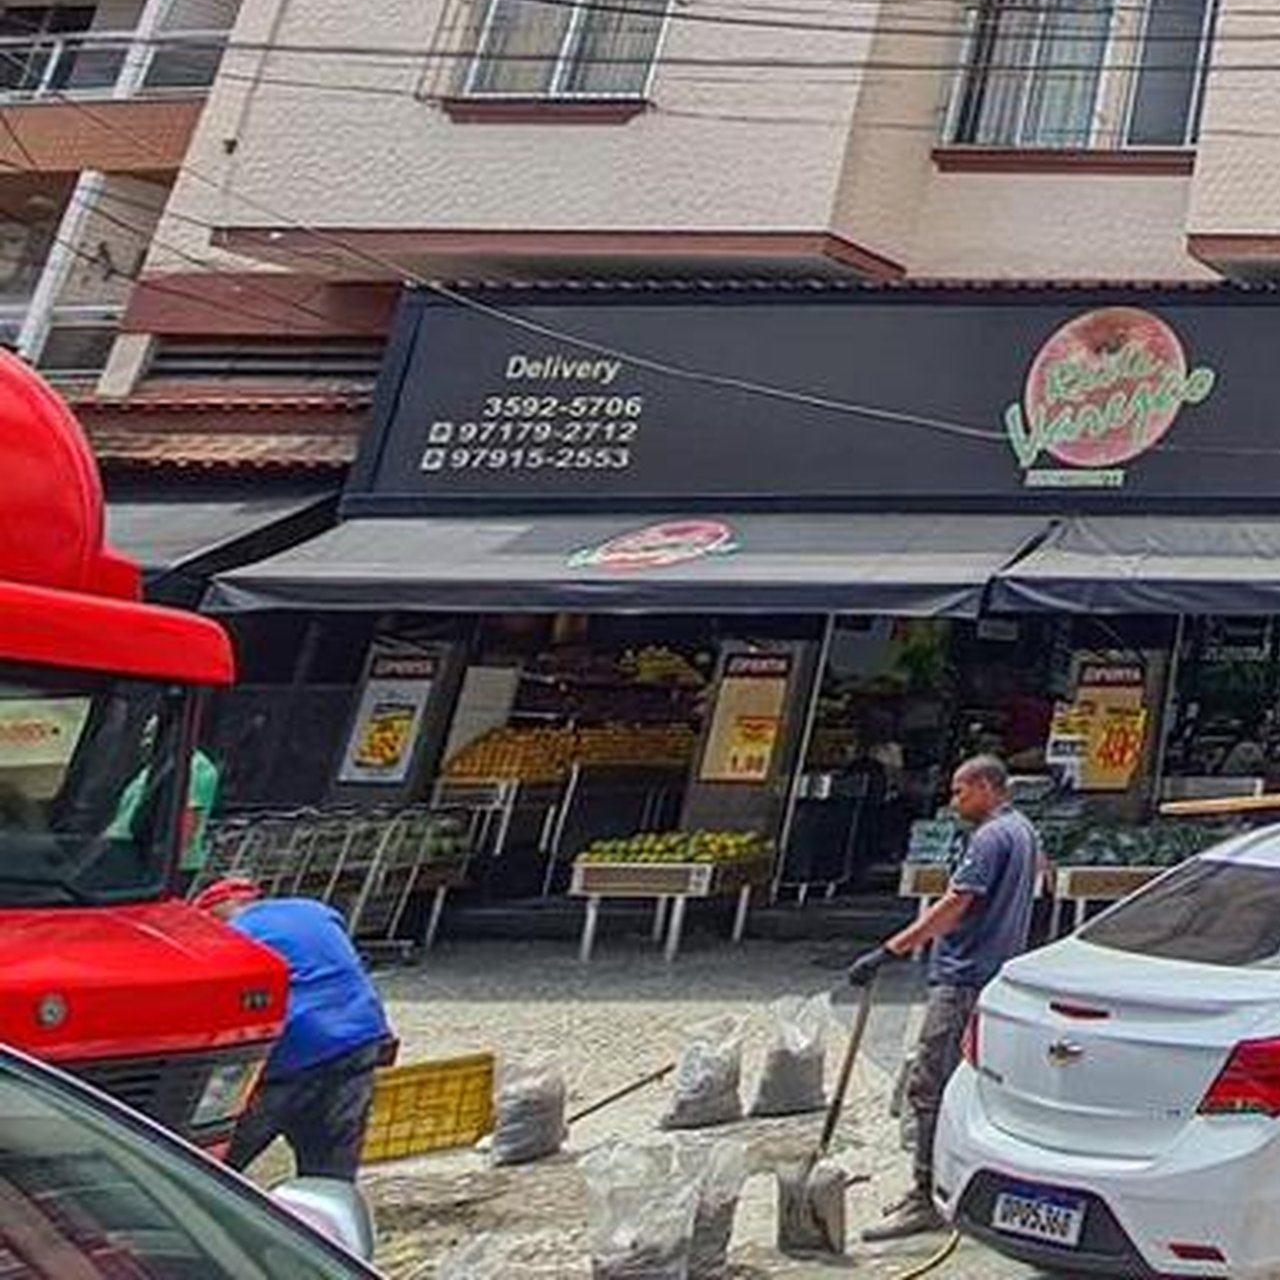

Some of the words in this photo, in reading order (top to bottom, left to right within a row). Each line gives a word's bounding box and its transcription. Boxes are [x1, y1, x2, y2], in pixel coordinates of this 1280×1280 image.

[505, 355, 623, 384] Delivery
[483, 395, 643, 418] 3592-5706
[458, 421, 639, 443] 97179-2712
[449, 448, 629, 469] 97915-2553
